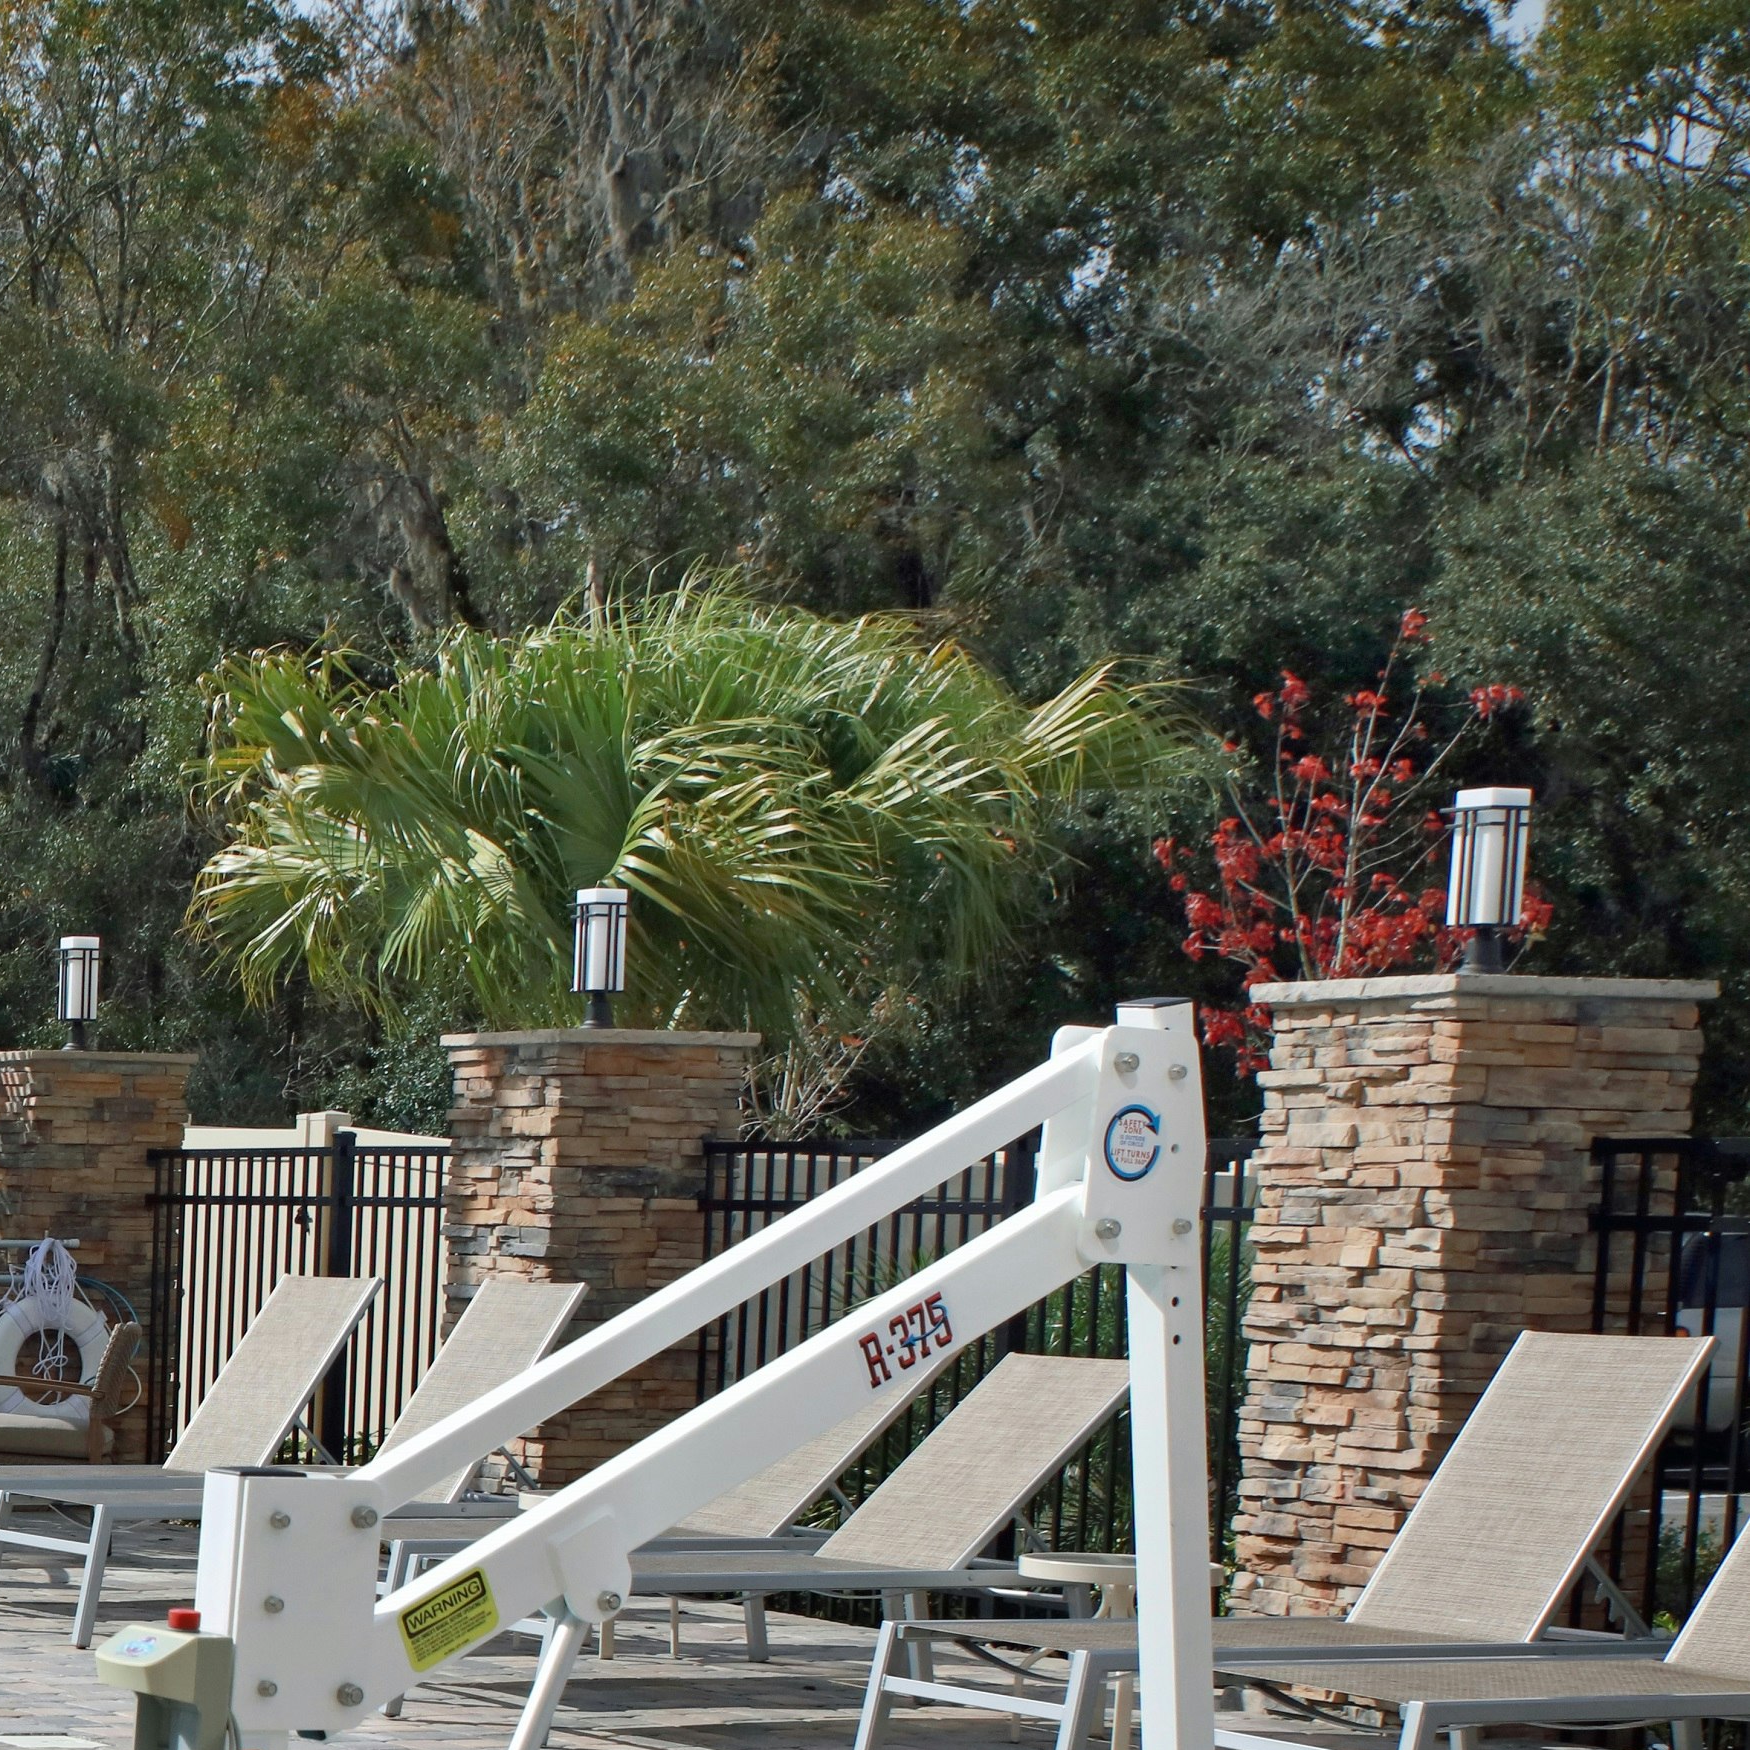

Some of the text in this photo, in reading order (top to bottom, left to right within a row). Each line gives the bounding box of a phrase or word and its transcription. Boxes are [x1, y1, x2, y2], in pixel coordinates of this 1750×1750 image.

[1124, 1127, 1142, 1135] ZONE
[1111, 1149, 1151, 1159] LIFT TURNS
[859, 1291, 953, 1389] R-375
[408, 1580, 480, 1630] WARNING
